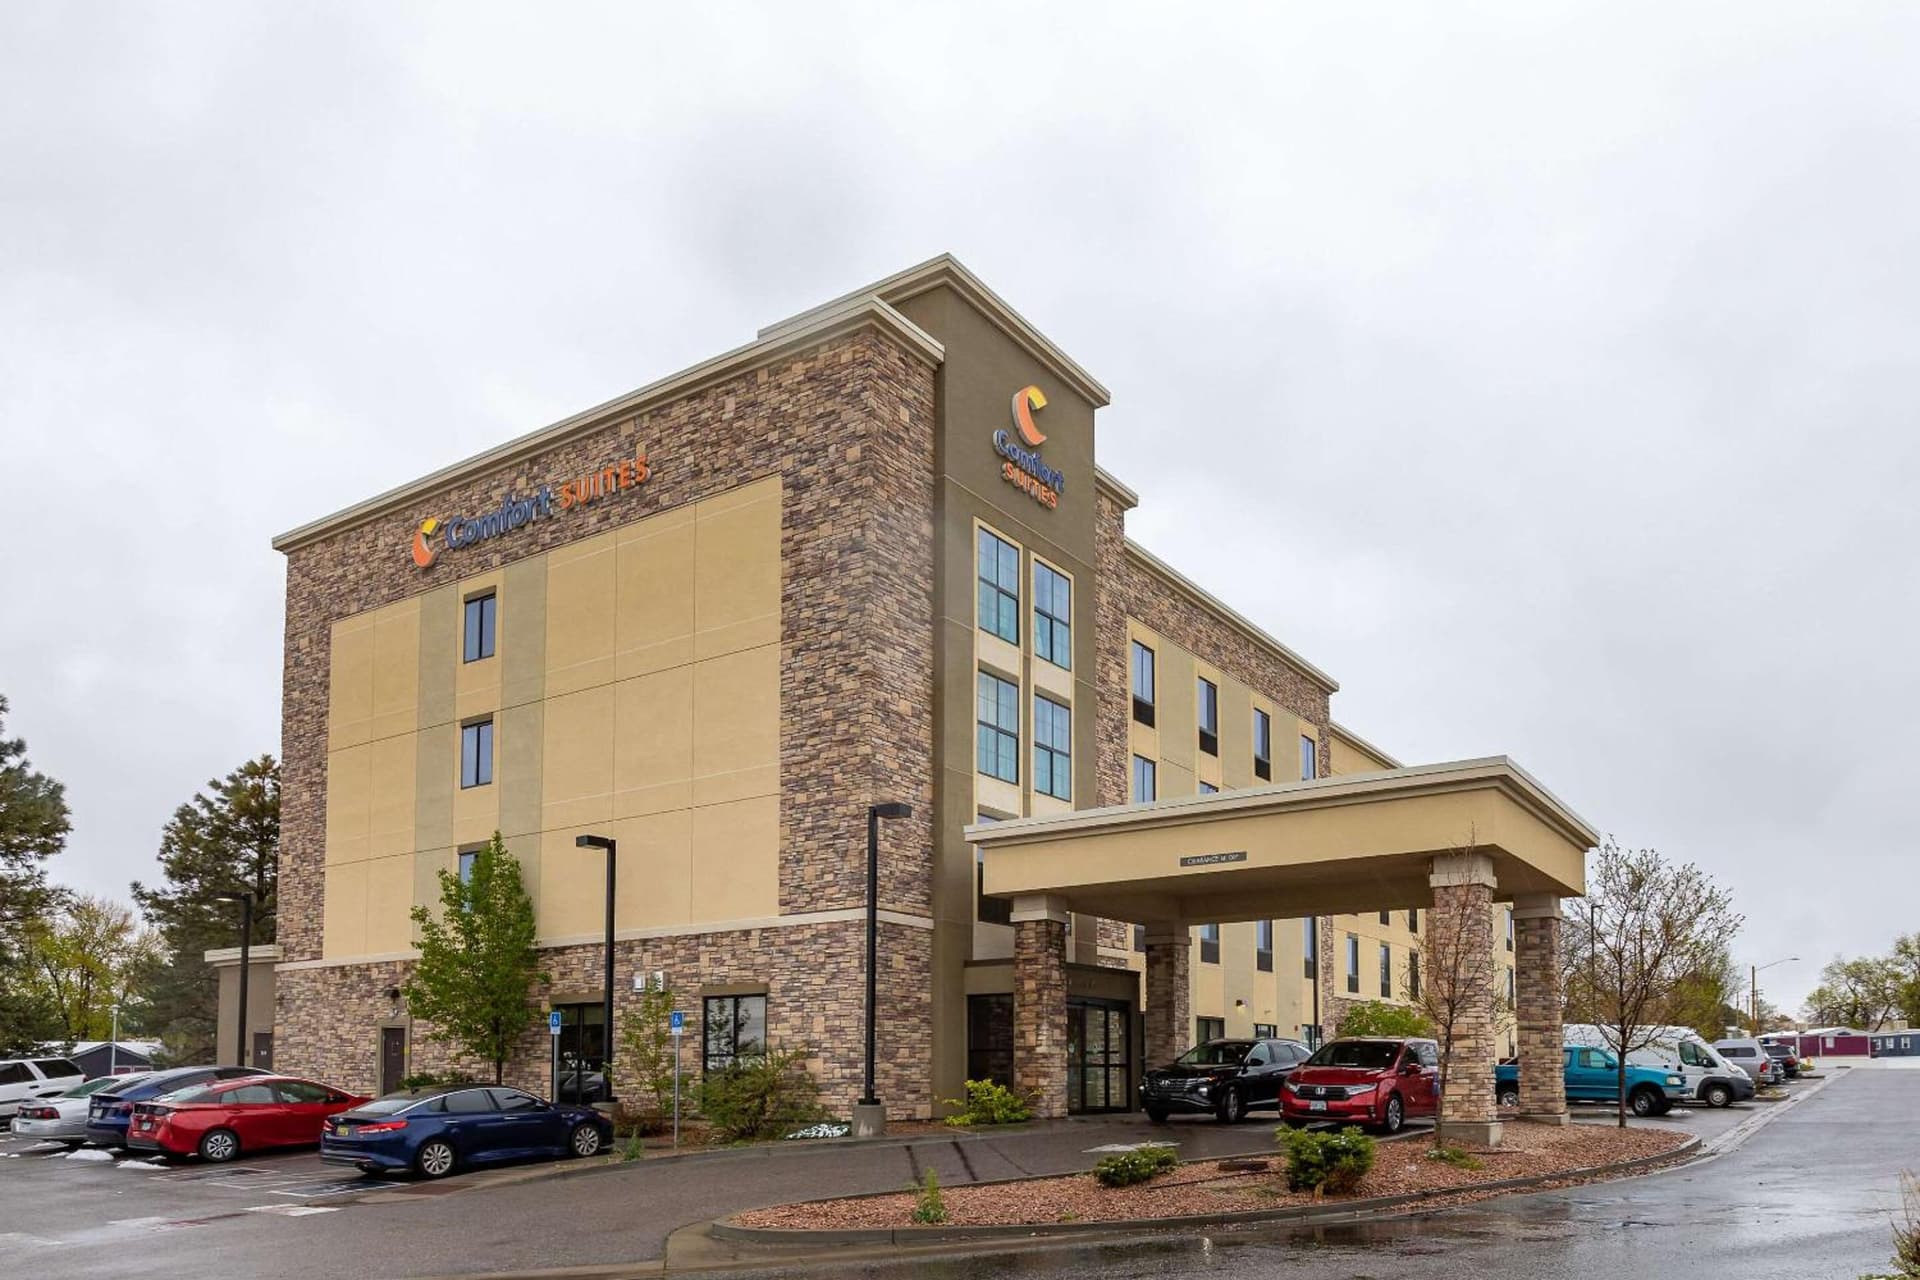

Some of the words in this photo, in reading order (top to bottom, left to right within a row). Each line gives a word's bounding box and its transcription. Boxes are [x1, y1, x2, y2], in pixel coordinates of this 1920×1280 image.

[993, 430, 1064, 494] Comfort
[1002, 462, 1057, 508] SUITES
[446, 485, 552, 548] Comfort
[560, 455, 651, 509] SUITES
